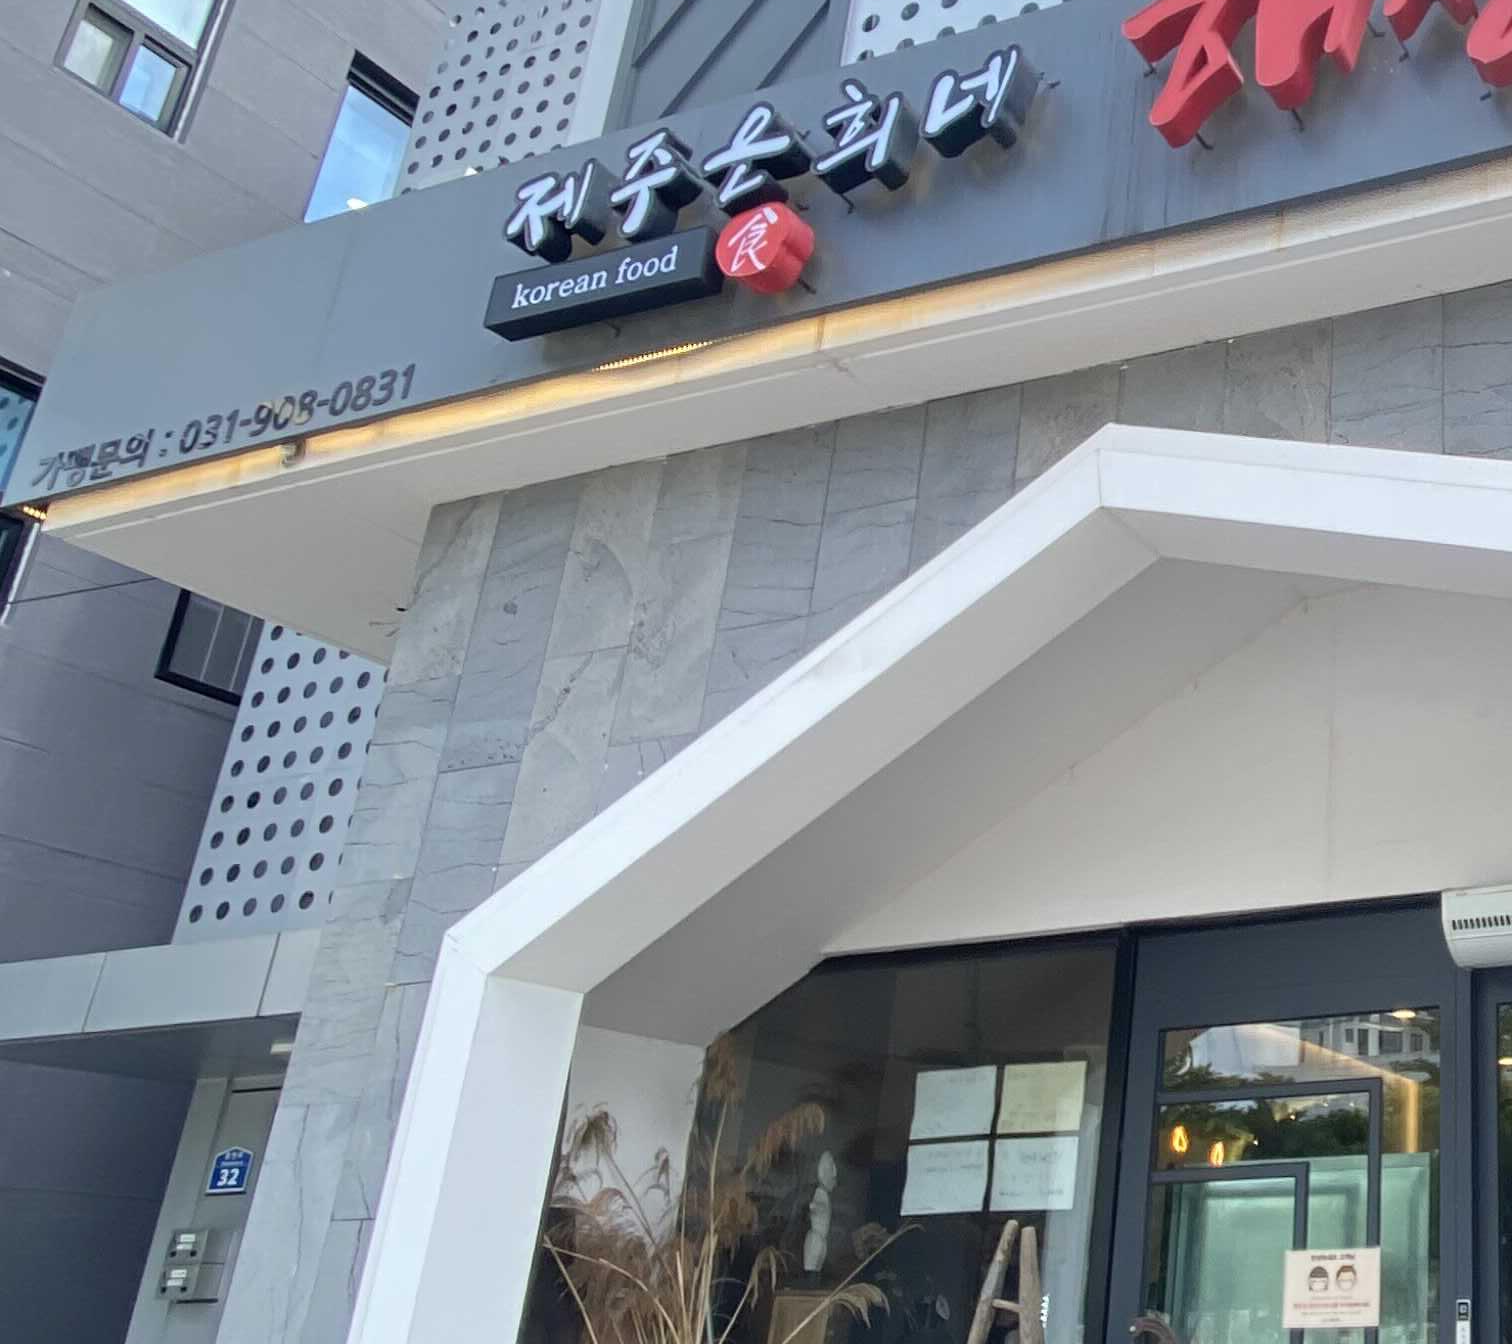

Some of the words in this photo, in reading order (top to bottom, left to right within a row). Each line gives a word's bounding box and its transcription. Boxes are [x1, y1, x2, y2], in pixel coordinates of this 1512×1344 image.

[504, 43, 1024, 258] 제주은희네
[511, 269, 607, 309] korean
[614, 245, 679, 285] food
[179, 363, 417, 455] 031-908-0831
[217, 1168, 240, 1186] 32
